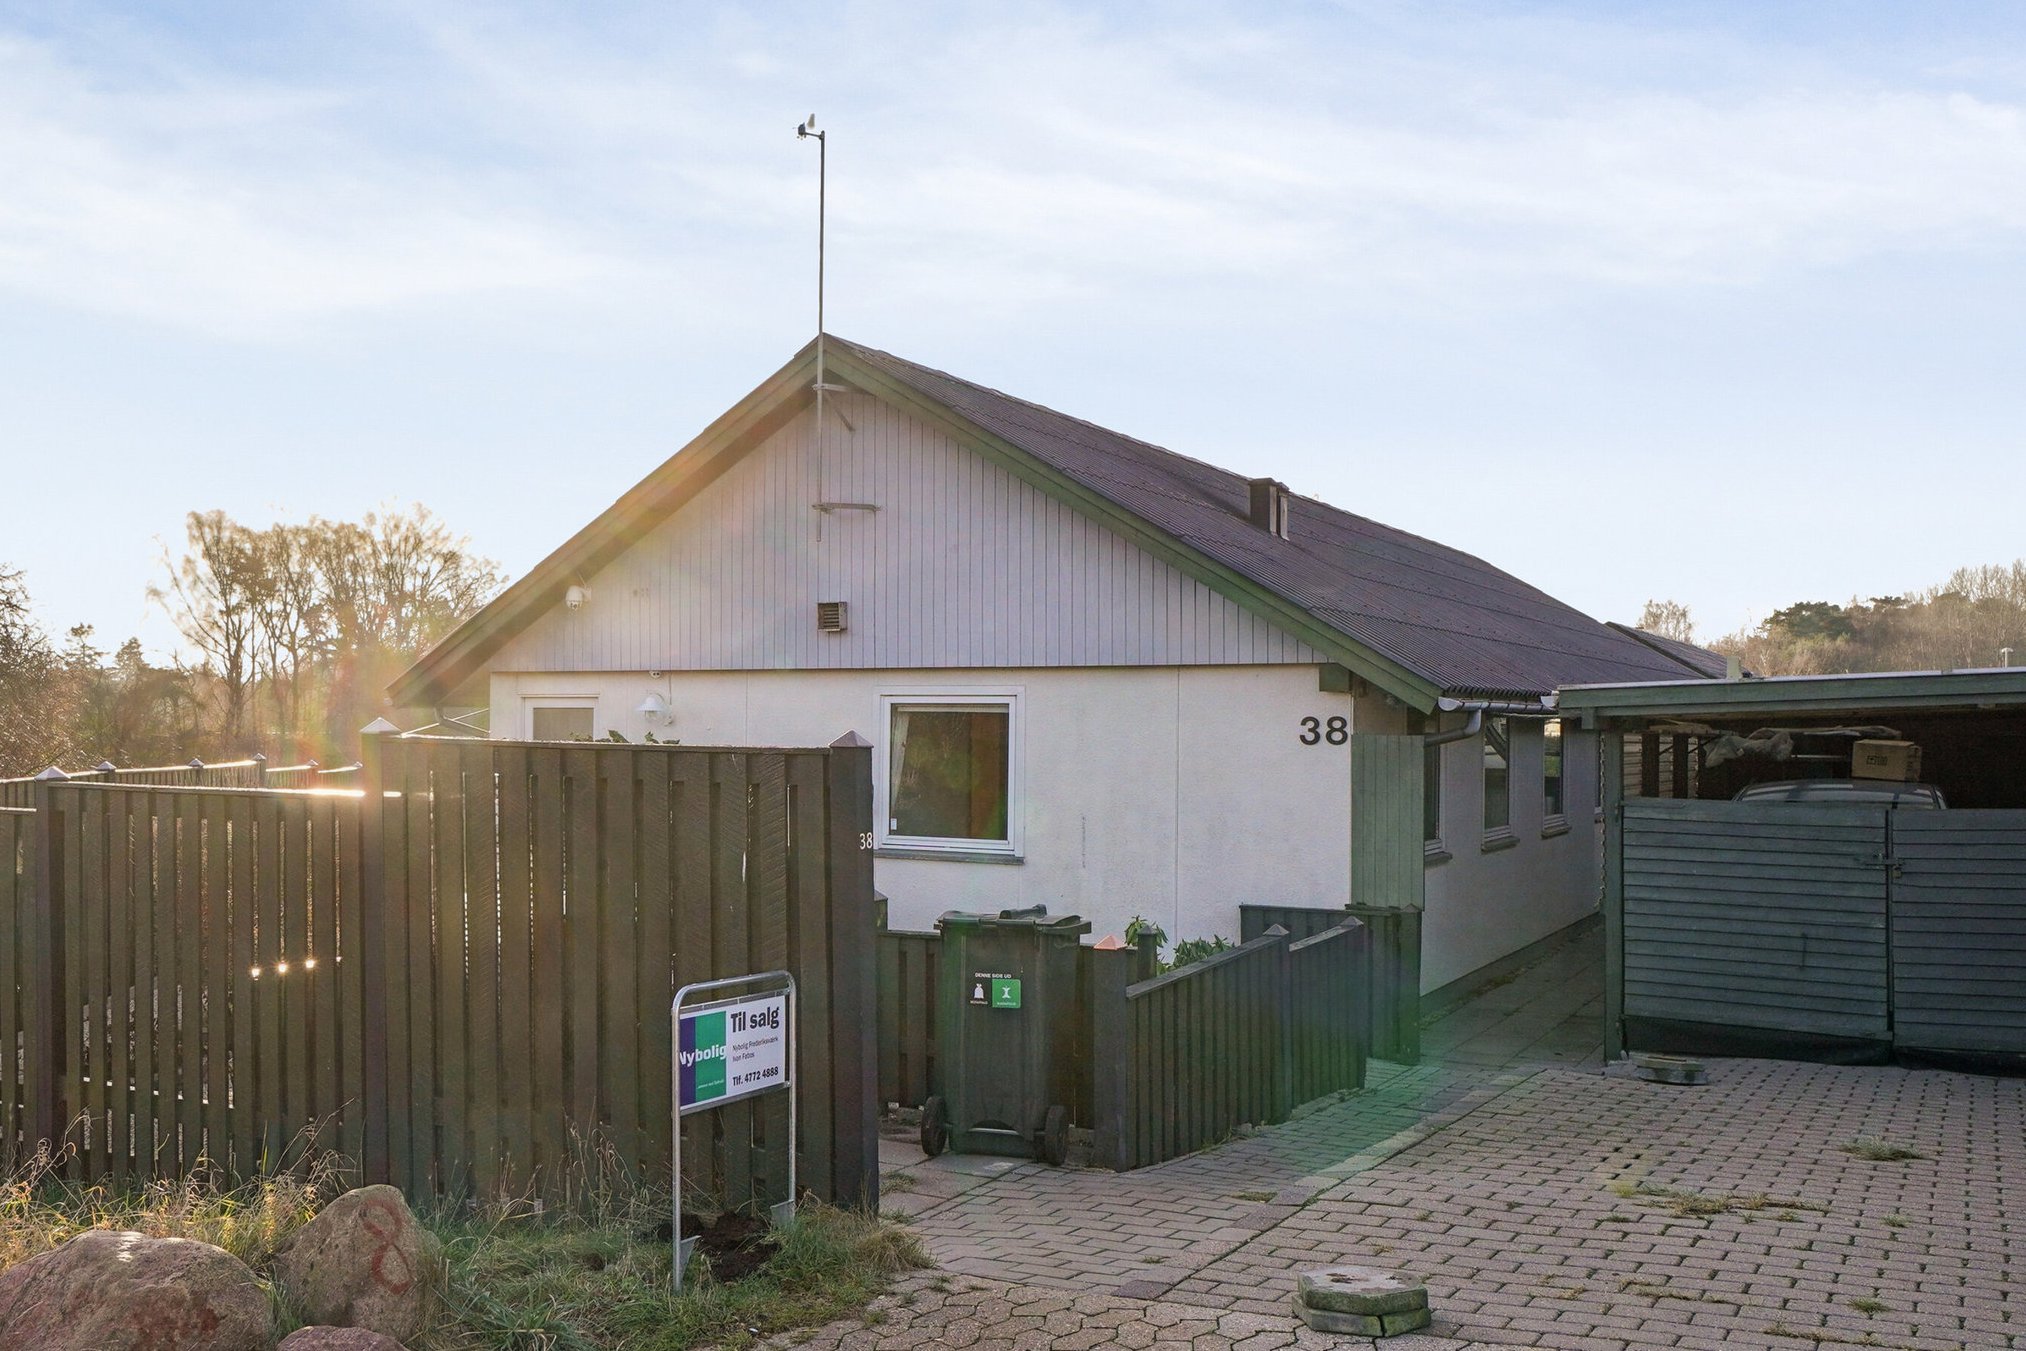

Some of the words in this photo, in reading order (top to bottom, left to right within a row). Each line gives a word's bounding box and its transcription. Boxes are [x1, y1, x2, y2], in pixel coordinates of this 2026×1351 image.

[1299, 716, 1348, 746] 38
[859, 832, 873, 850] 38
[730, 1011, 746, 1033] Til
[750, 1006, 780, 1030] salg
[732, 1075, 744, 1086] Tlf.
[744, 1070, 761, 1083] 4772
[761, 1066, 779, 1078] 4888
